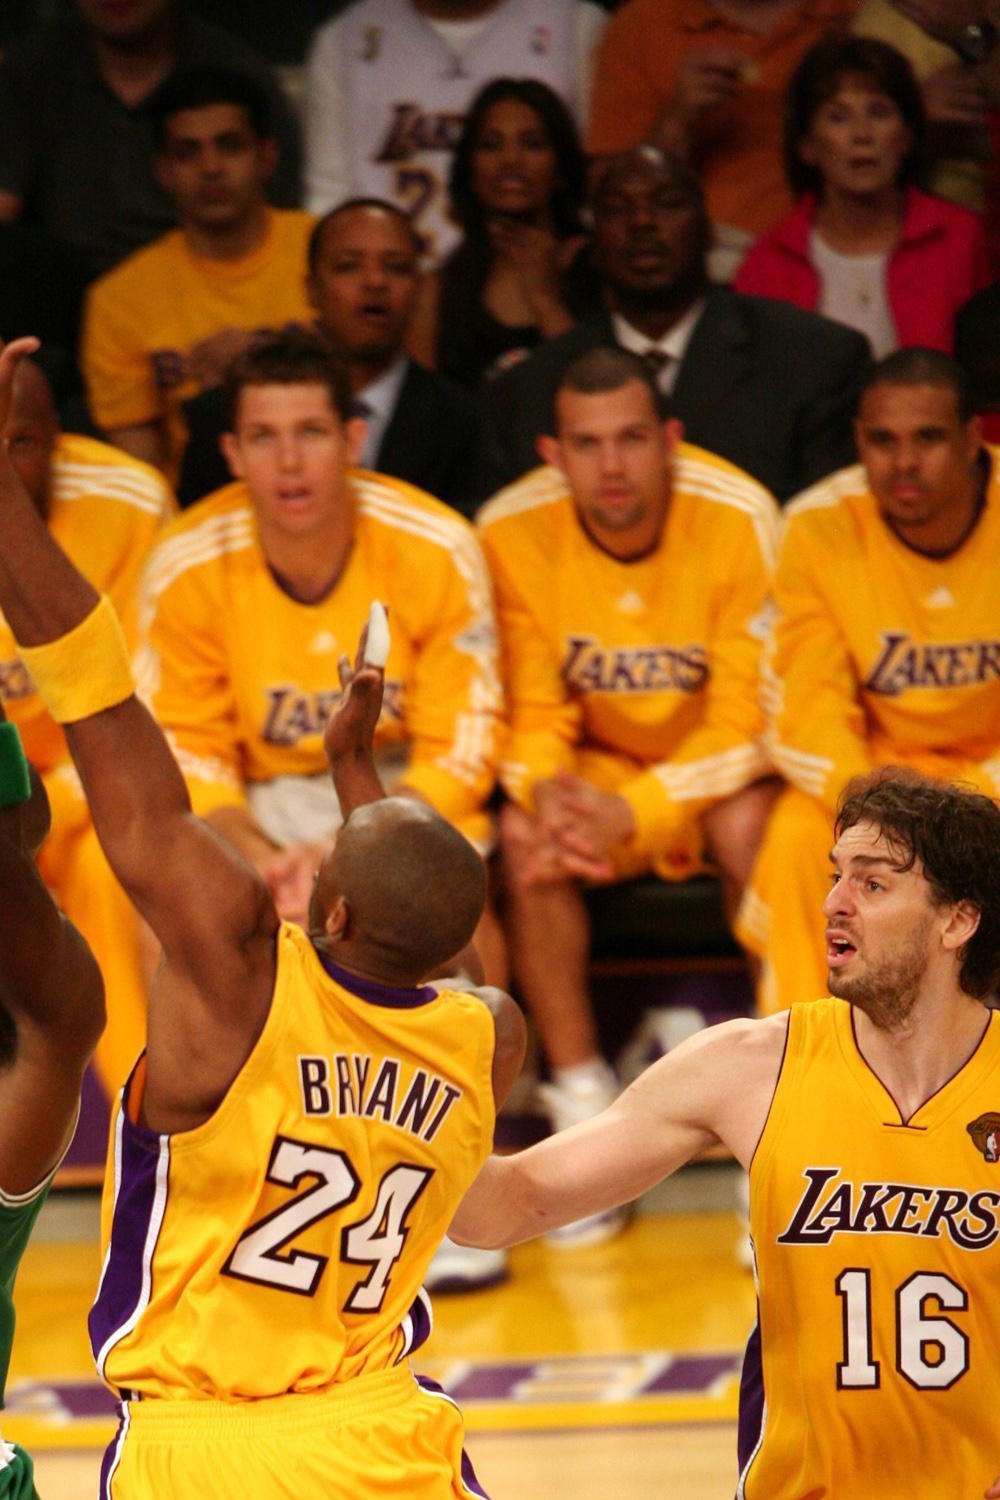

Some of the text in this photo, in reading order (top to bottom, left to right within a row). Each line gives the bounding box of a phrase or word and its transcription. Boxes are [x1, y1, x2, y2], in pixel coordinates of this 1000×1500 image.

[560, 636, 710, 694] LAKERS
[298, 1054, 463, 1144] BRYANT
[220, 1133, 436, 1315] 24
[777, 1167, 1000, 1251] LAKERS
[835, 1267, 970, 1391] 16
